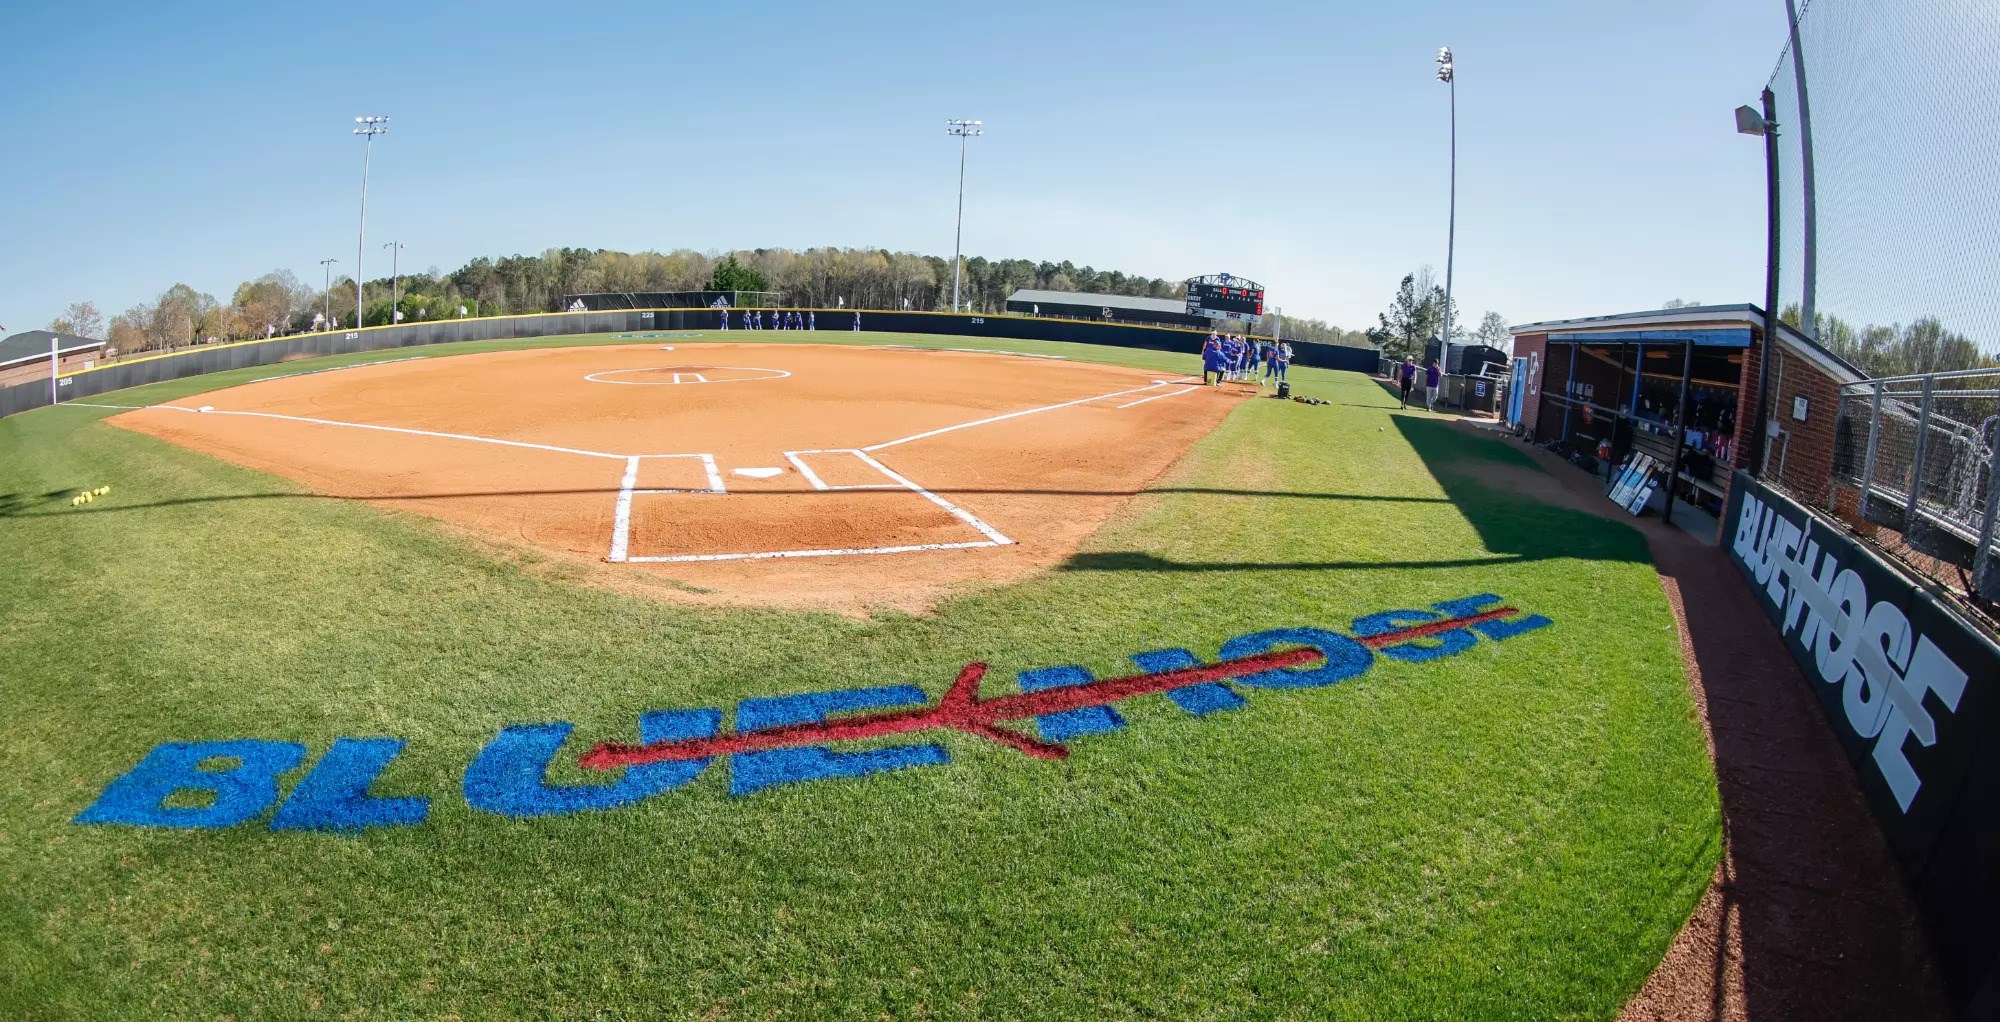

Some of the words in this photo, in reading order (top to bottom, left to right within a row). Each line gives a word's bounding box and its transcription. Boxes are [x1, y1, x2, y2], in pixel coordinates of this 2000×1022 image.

[59, 377, 73, 386] 205
[345, 332, 358, 340] 215
[72, 685, 949, 834] BLUE
[1018, 594, 1552, 741] HOSE
[1733, 491, 1802, 609] BLUE
[1786, 536, 1969, 814] HOSE
